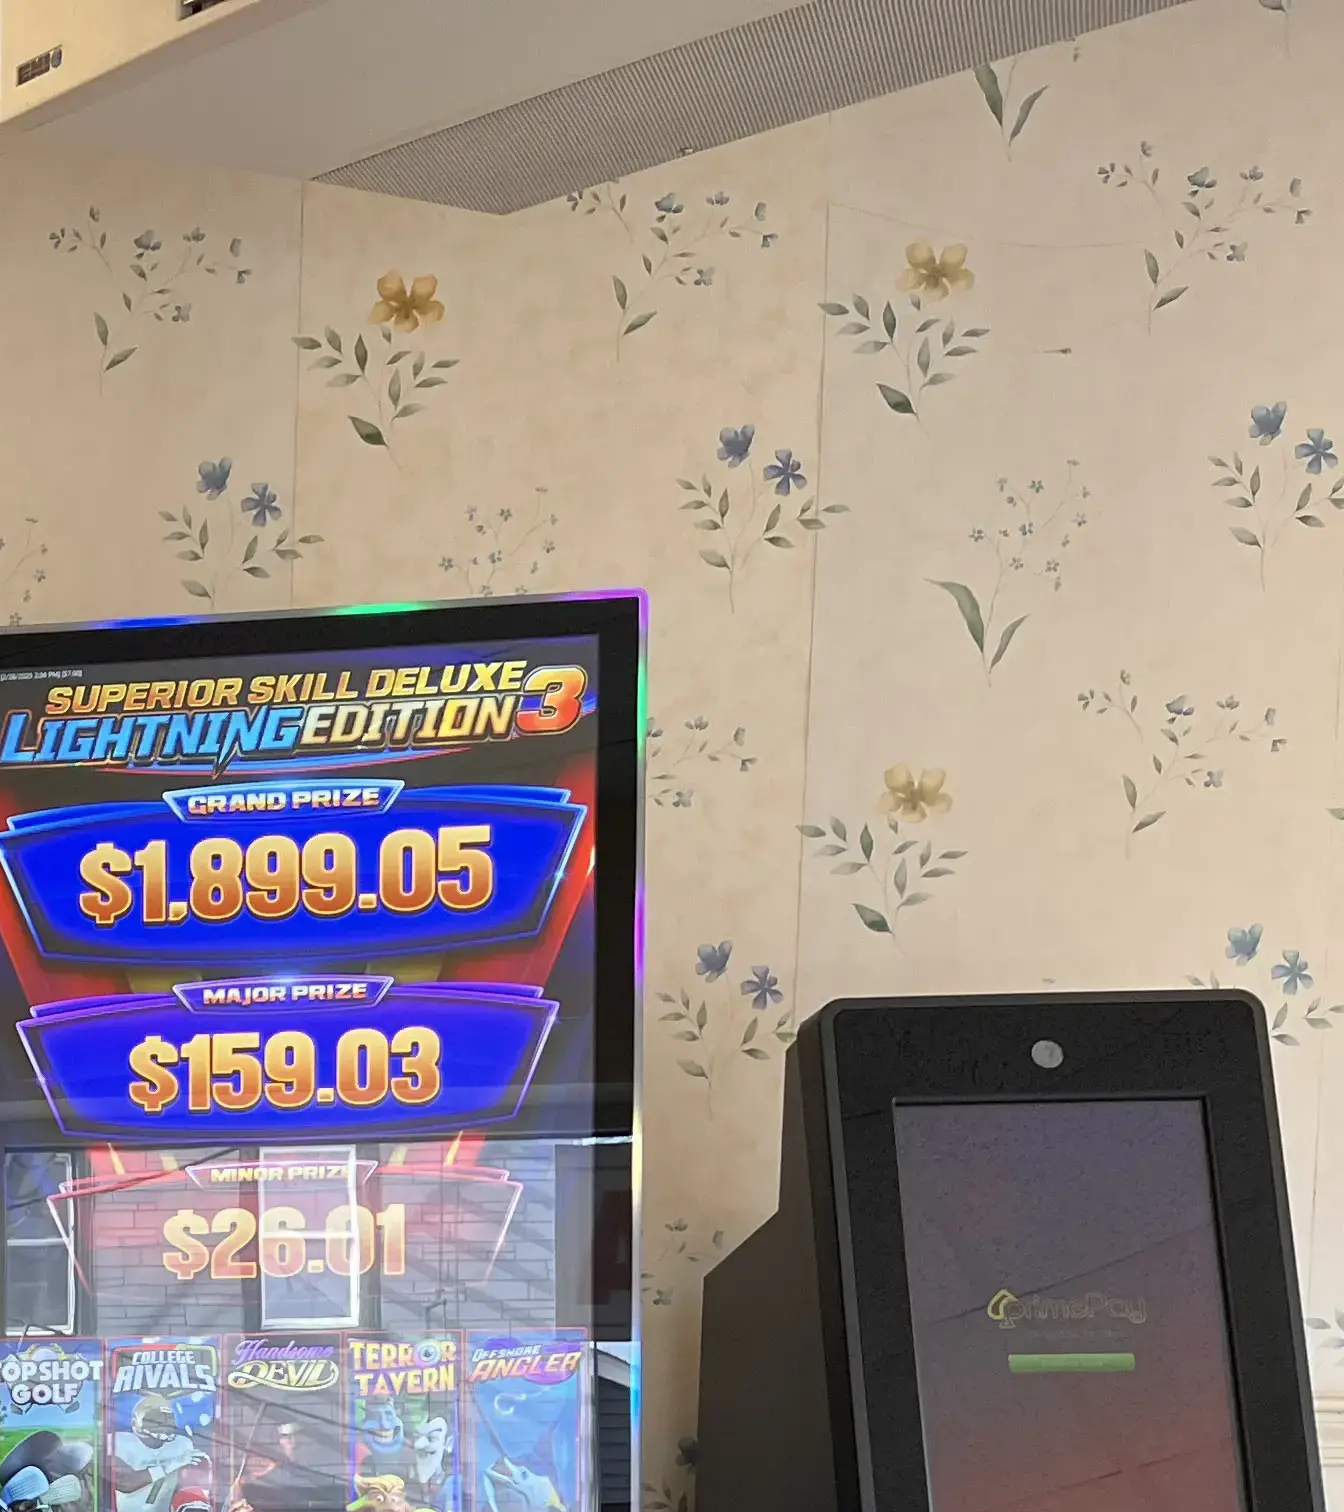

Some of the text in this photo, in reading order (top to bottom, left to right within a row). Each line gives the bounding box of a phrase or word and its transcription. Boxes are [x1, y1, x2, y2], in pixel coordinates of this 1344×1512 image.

[46, 661, 527, 715] SUPERIOR SKILL DELUXE
[300, 696, 515, 746] EDITION
[515, 666, 584, 736] 3
[188, 788, 379, 816] GRAND PRIZE
[78, 826, 494, 926] $1,899.05
[203, 982, 368, 1006] MAJOR PRIZE
[128, 1026, 440, 1113] $159.03
[211, 1165, 354, 1183] MINOR PRIZE
[162, 1203, 407, 1280] $26.01
[131, 1351, 196, 1366] COLLEGE
[231, 1339, 335, 1364] Handsome
[348, 1338, 458, 1371] TERROR
[471, 1344, 542, 1363] OFFSHORE
[113, 1364, 217, 1393] RIVALS
[228, 1358, 339, 1391] DEVIL
[354, 1362, 455, 1397] TAVERN
[467, 1351, 582, 1386] ANGLER
[12, 1383, 79, 1405] GOLF
